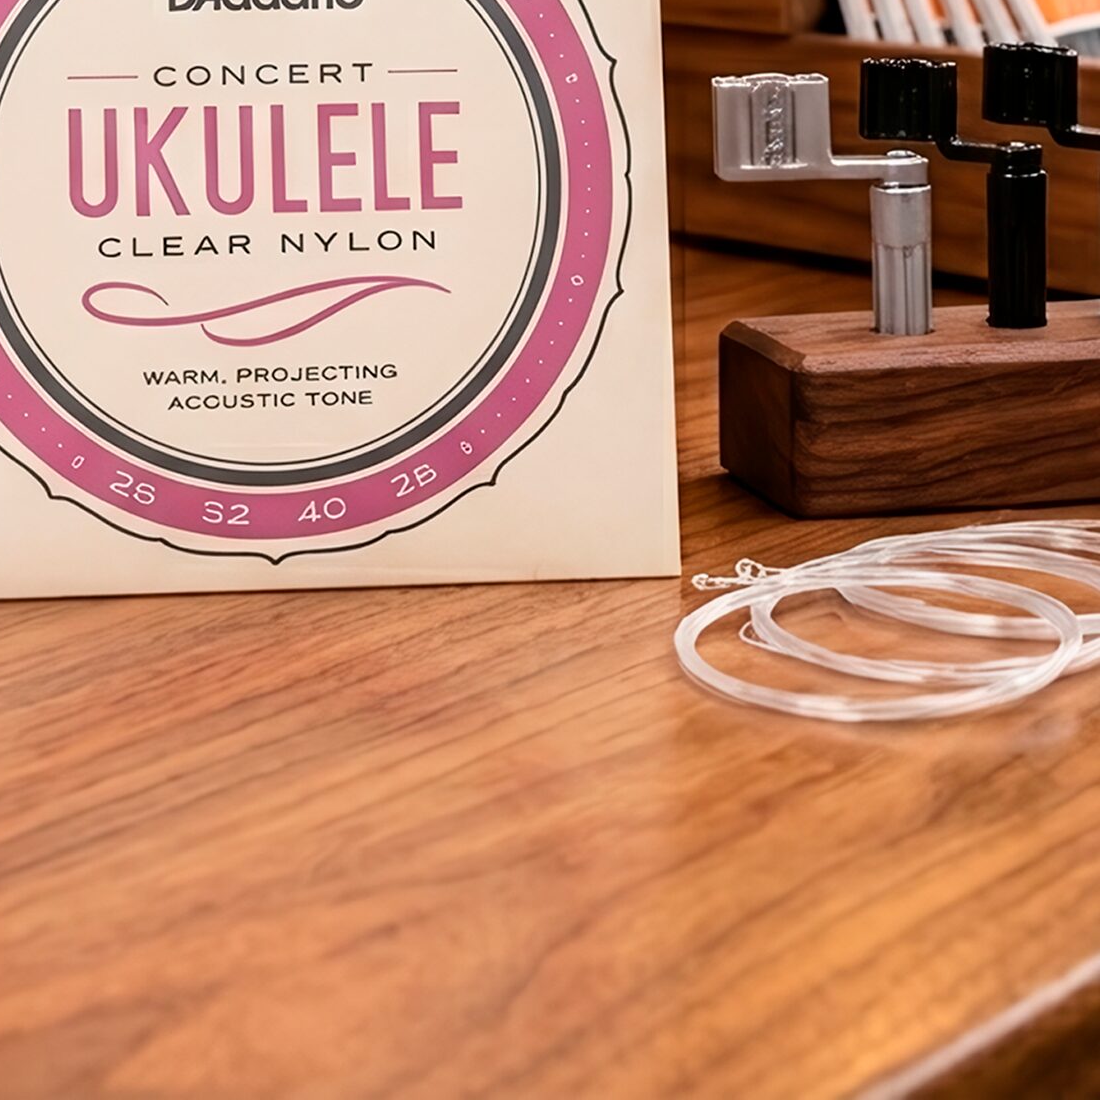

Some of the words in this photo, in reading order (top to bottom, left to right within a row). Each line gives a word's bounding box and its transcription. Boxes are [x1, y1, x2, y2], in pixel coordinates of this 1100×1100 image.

[153, 62, 373, 88] CONCERT
[68, 101, 463, 218] UKULELE
[97, 234, 252, 259] CLEAR
[280, 229, 437, 254] NYLON
[236, 363, 399, 384] PROJECTING
[167, 392, 296, 411] ACOUSTIC
[304, 389, 374, 407] TONE
[298, 496, 347, 522] 40
